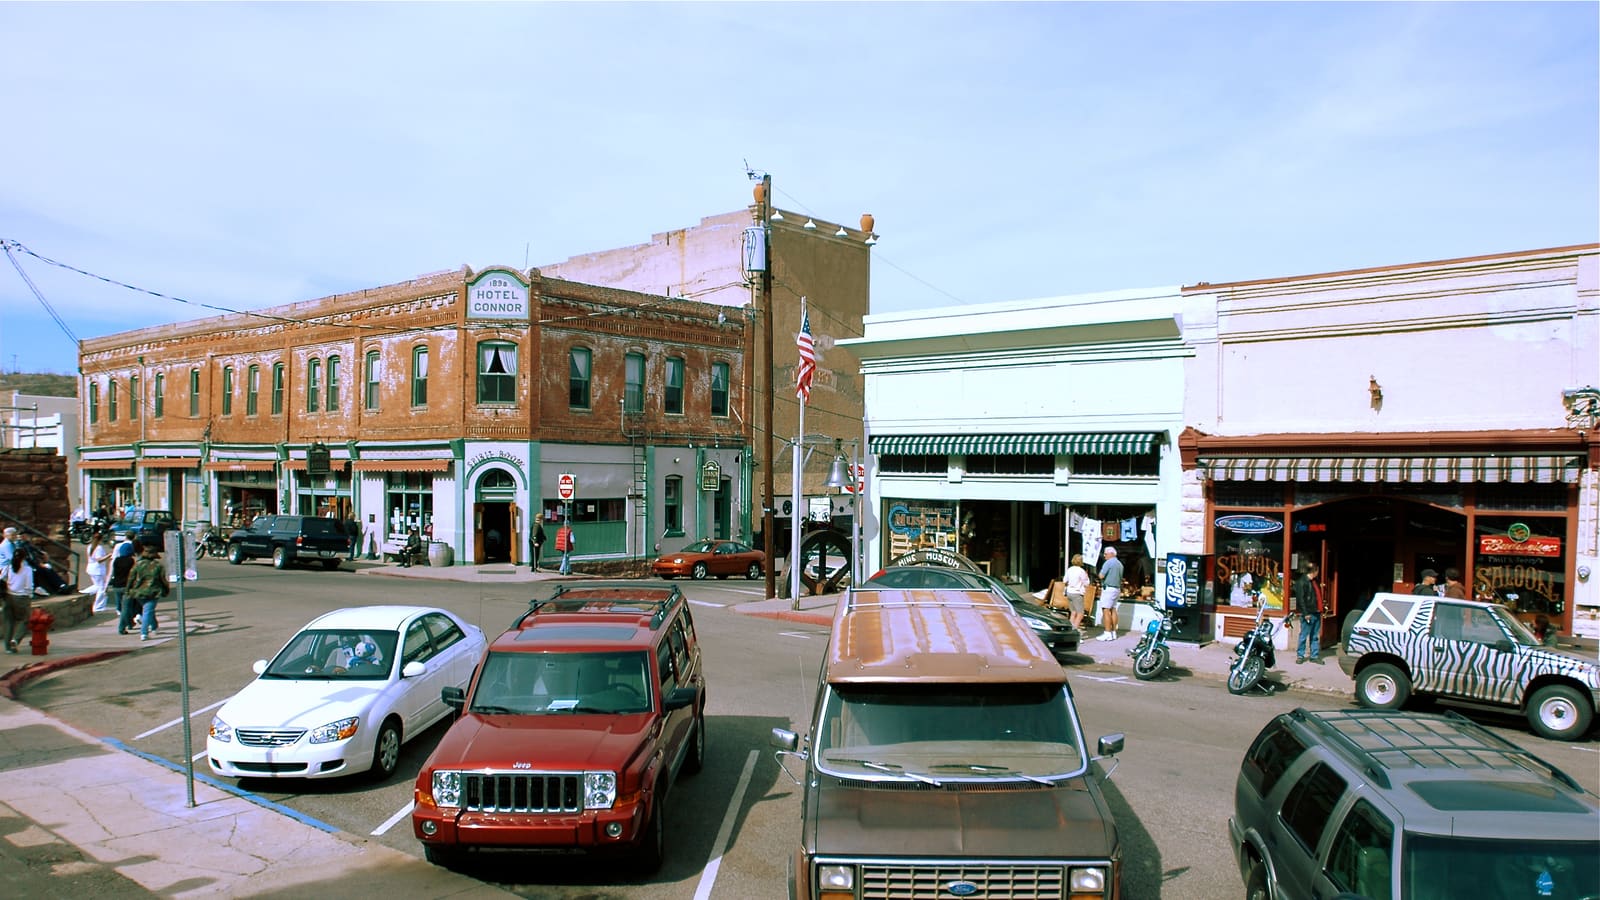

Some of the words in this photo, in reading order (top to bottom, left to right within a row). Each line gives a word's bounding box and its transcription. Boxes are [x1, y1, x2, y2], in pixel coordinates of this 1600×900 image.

[477, 290, 519, 300] HOTEL
[474, 303, 522, 312] CONNOR
[1481, 538, 1558, 552] Budweiser
[897, 554, 917, 567] MINE
[925, 552, 960, 569] MUSEUM
[1216, 554, 1281, 587] SALOON
[1475, 564, 1560, 602] SALOON
